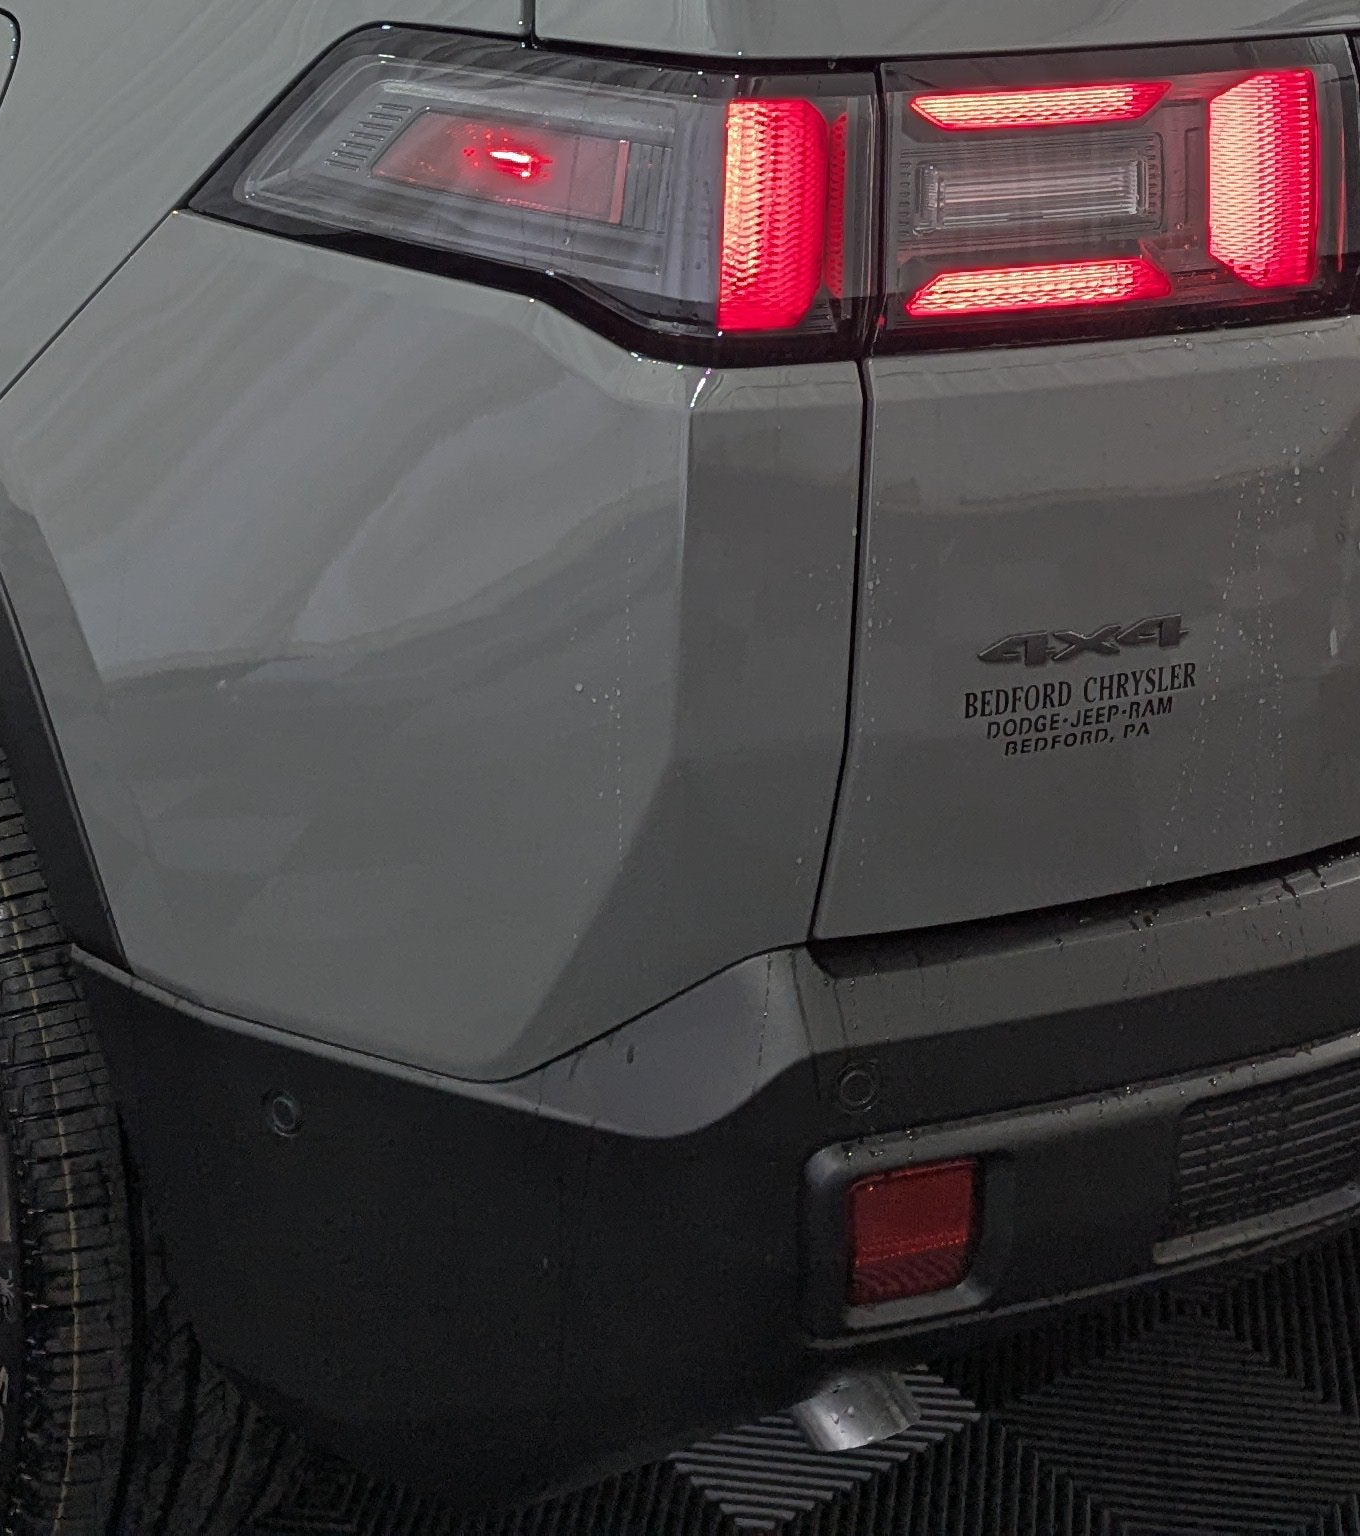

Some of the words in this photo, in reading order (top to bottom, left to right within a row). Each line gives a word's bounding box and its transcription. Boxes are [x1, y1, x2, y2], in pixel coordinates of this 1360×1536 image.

[963, 680, 1073, 720] BEDFORD
[1083, 661, 1197, 703] CHRYSLER
[1004, 726, 1115, 757] BEDFORD,
[1123, 720, 1151, 740] PA
